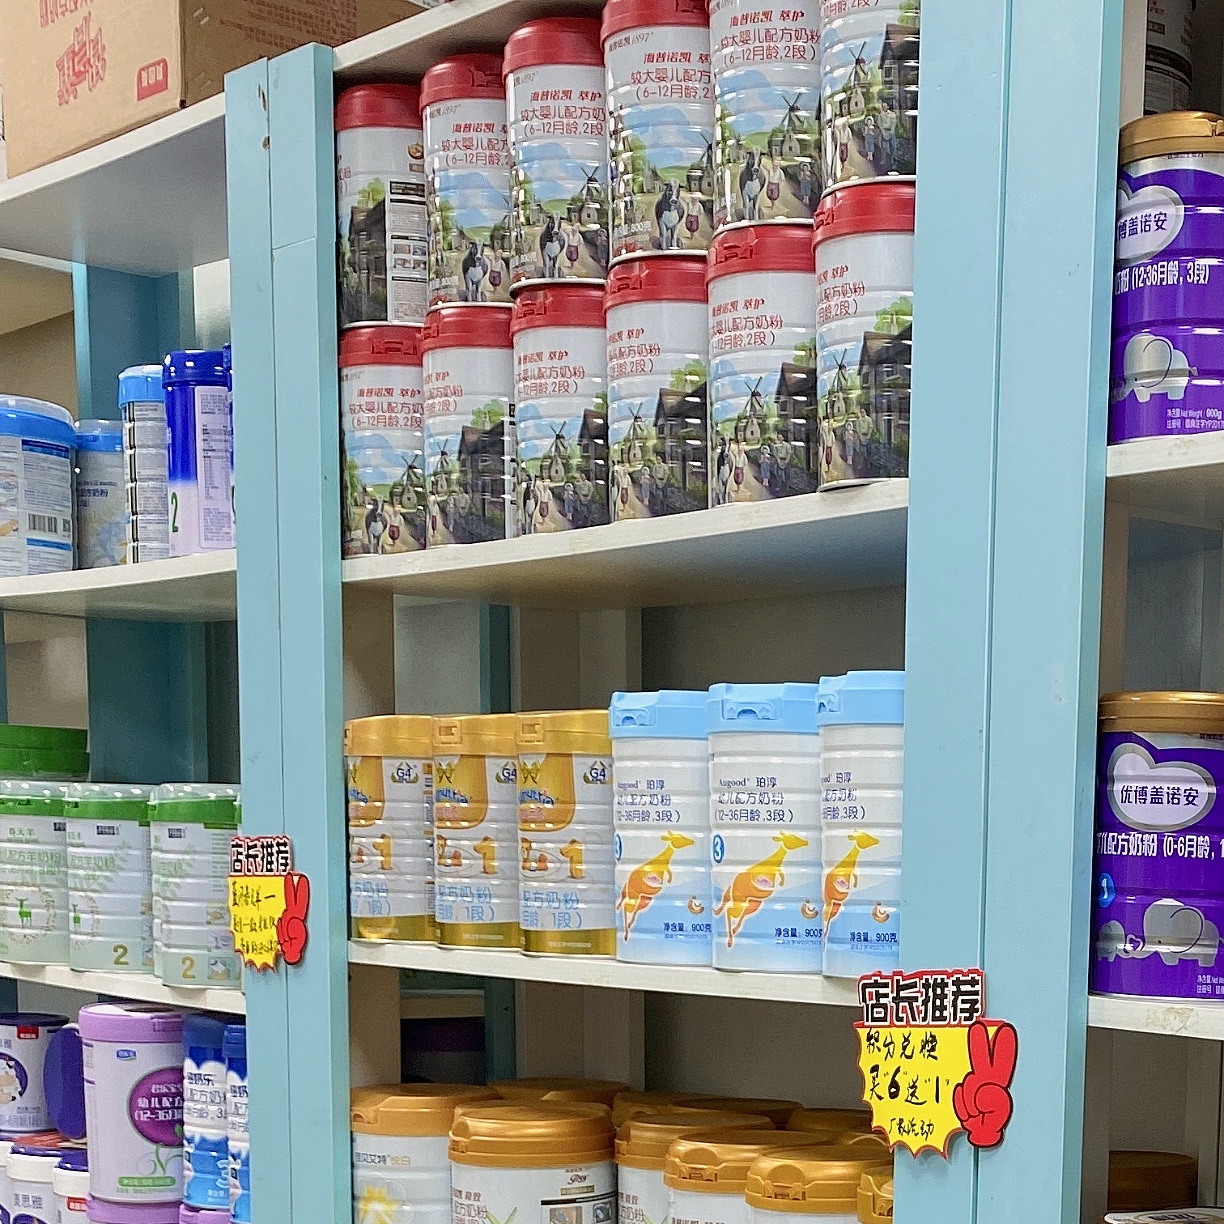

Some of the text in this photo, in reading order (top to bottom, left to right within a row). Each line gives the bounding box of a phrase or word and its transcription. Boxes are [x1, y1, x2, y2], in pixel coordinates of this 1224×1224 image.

[1120, 785, 1199, 807] 优博盖诺安
[113, 944, 129, 965] 2
[181, 956, 195, 979] 2
[861, 974, 981, 1023] 店长推荐
